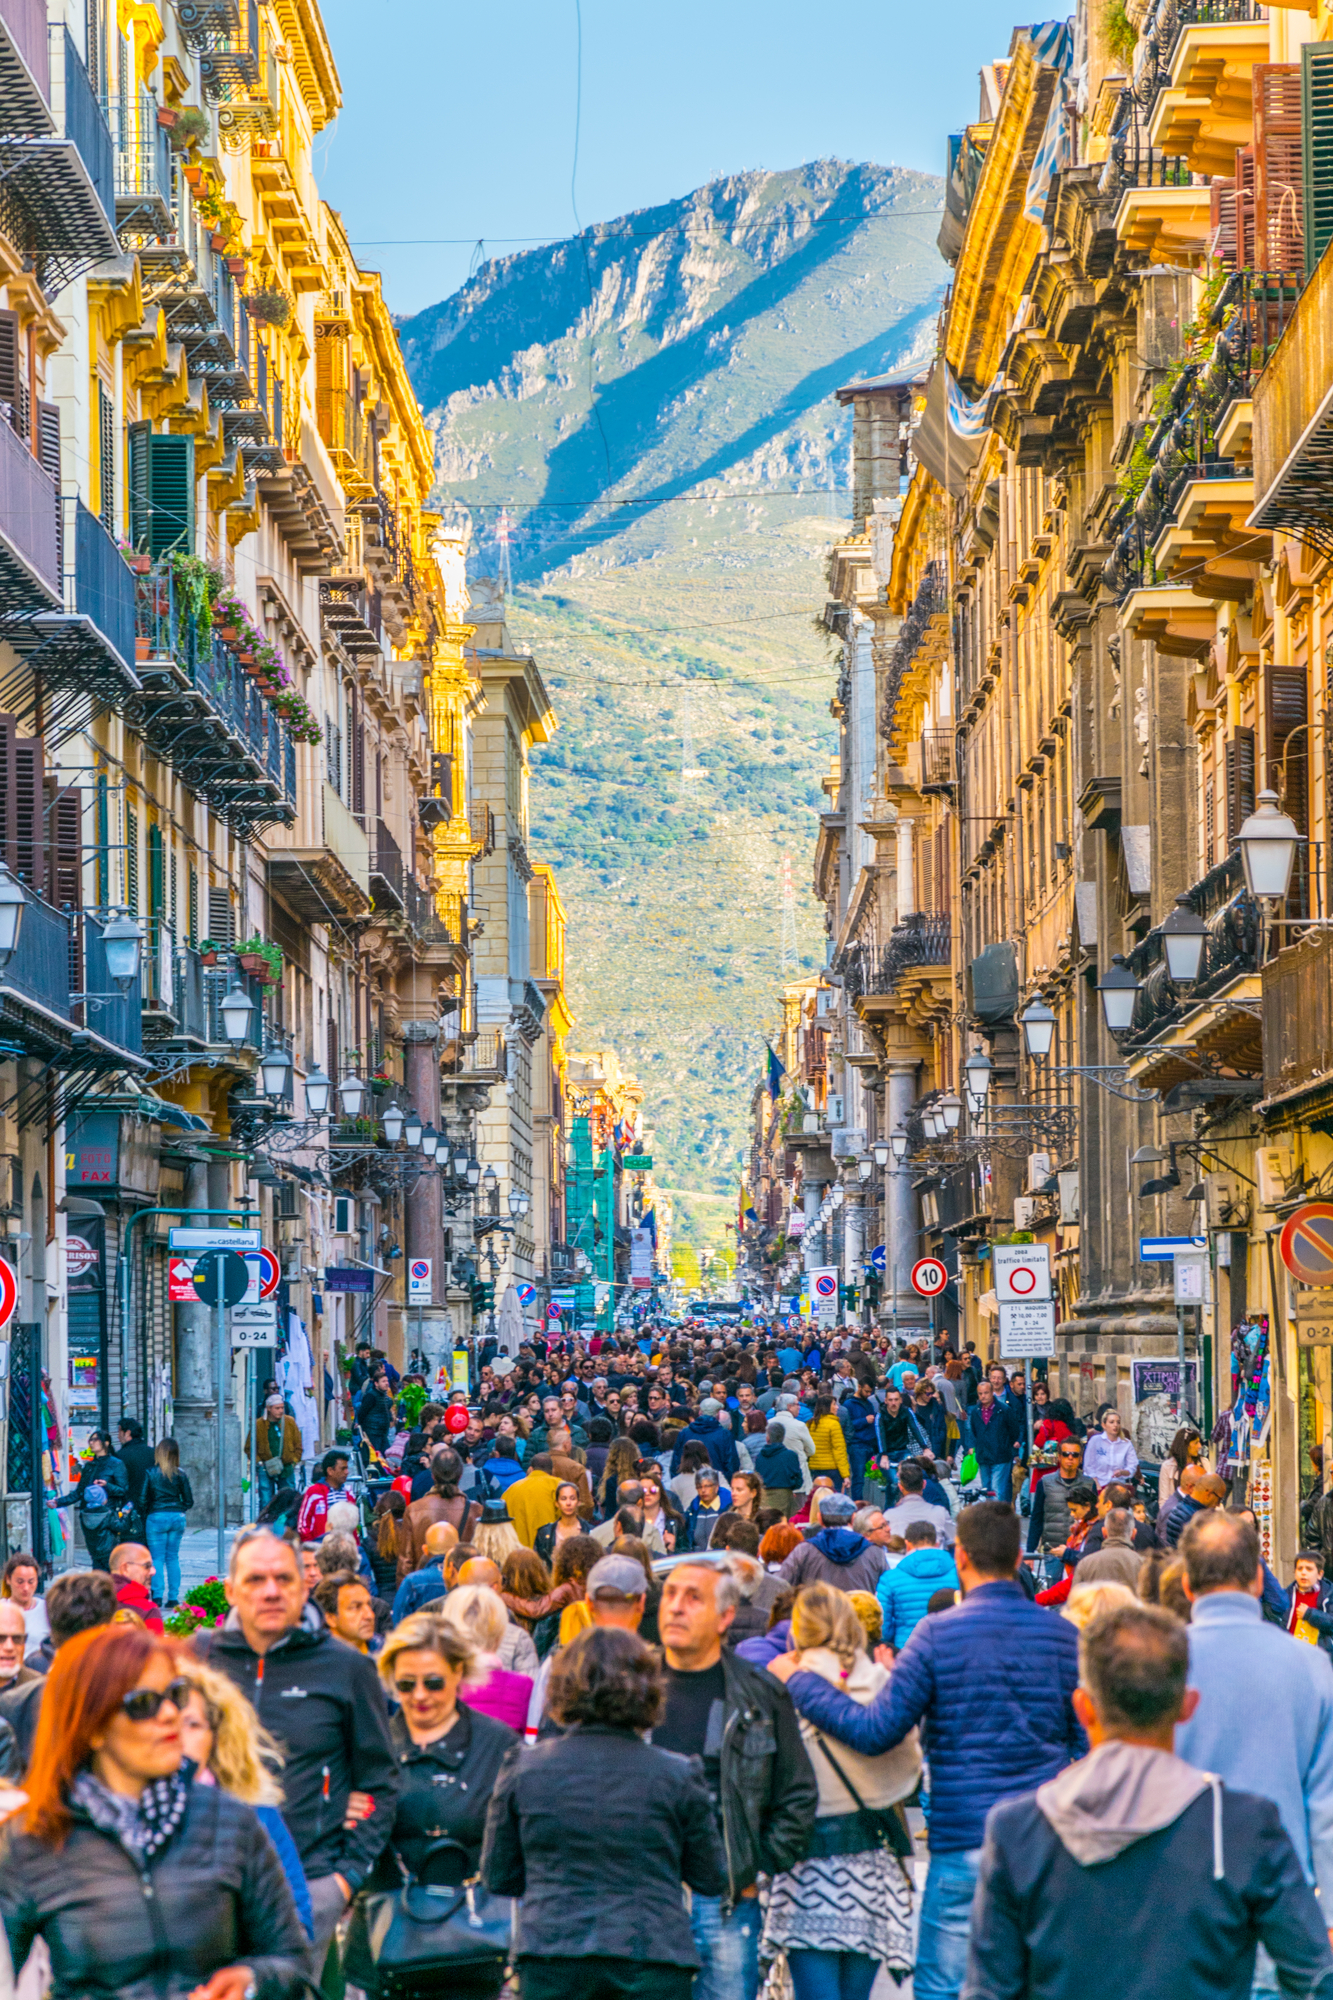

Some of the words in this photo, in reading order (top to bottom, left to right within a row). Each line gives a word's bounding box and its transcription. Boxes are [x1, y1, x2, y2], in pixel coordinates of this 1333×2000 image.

[81, 1153, 111, 1164] FOTO
[81, 1171, 111, 1182] FAX
[1021, 1255, 1046, 1263] limitato
[922, 1268, 938, 1286] 10
